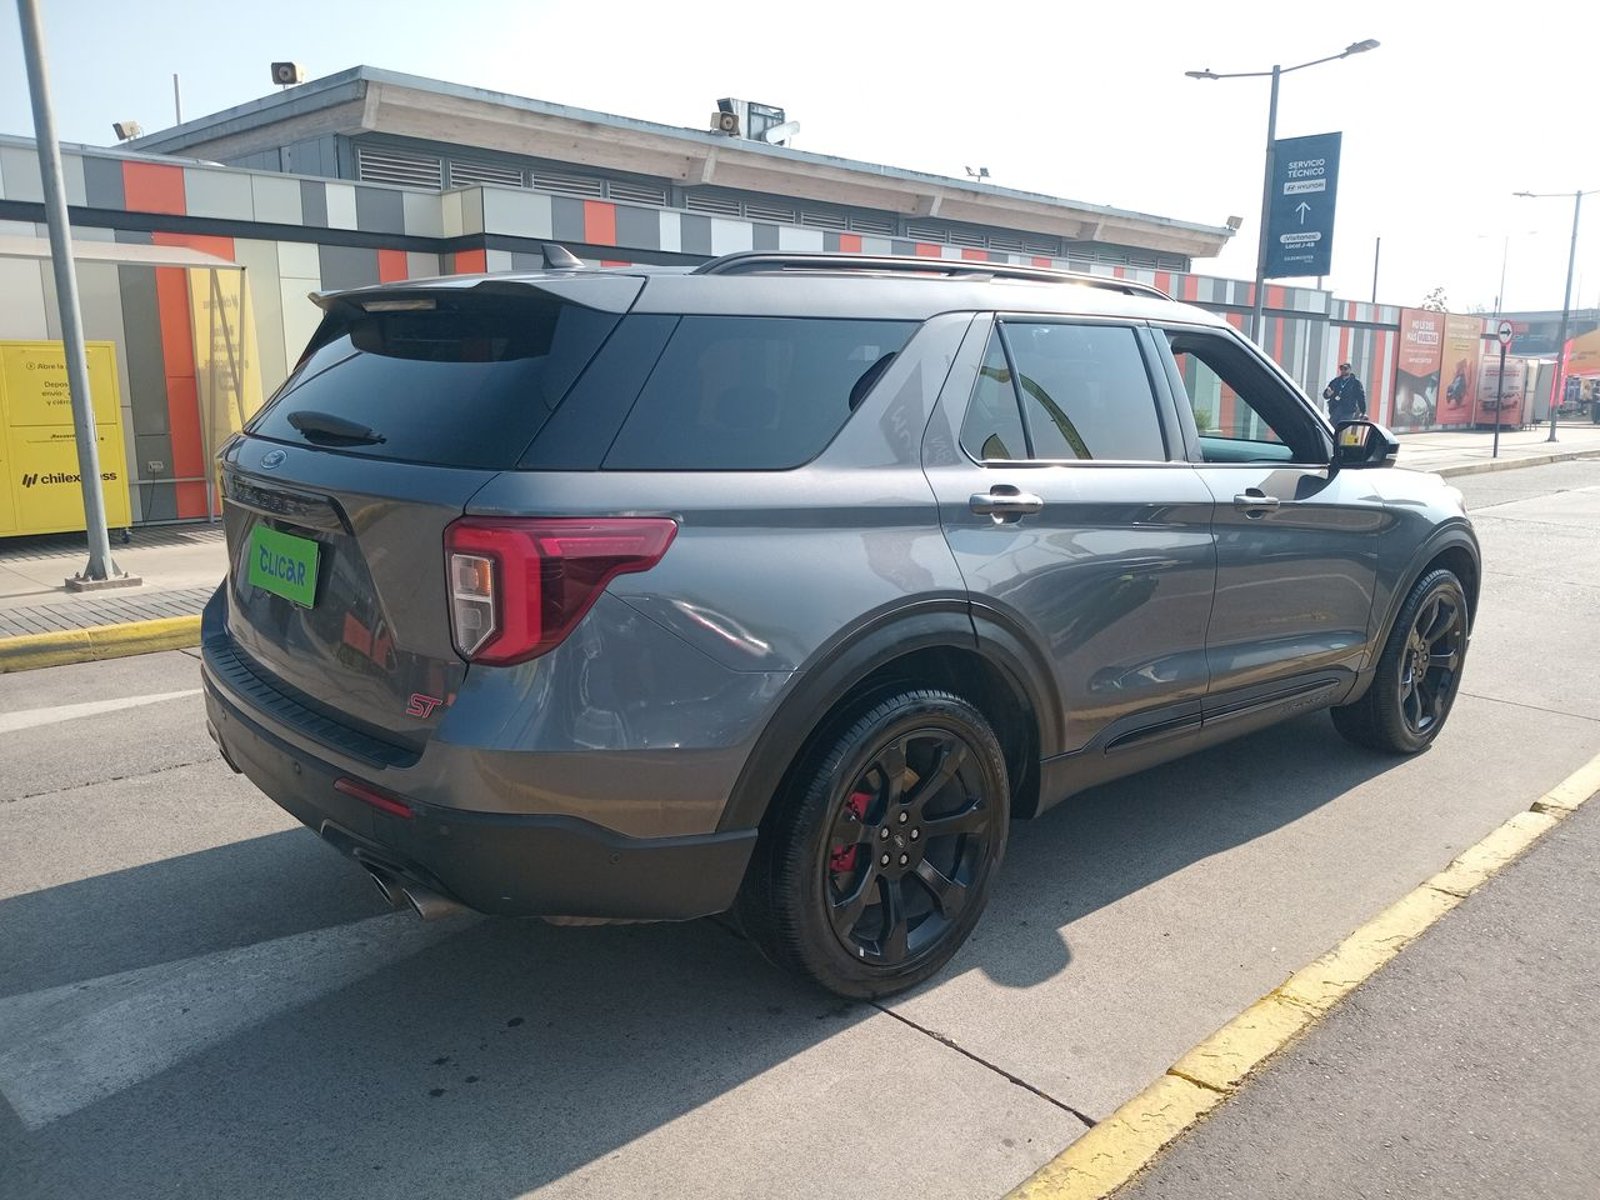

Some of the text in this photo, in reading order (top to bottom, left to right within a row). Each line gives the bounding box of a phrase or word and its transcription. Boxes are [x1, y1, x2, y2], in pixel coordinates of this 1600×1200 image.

[1288, 158, 1326, 170] SERVICIO
[40, 472, 118, 485] chilexss
[405, 693, 443, 718] ST
